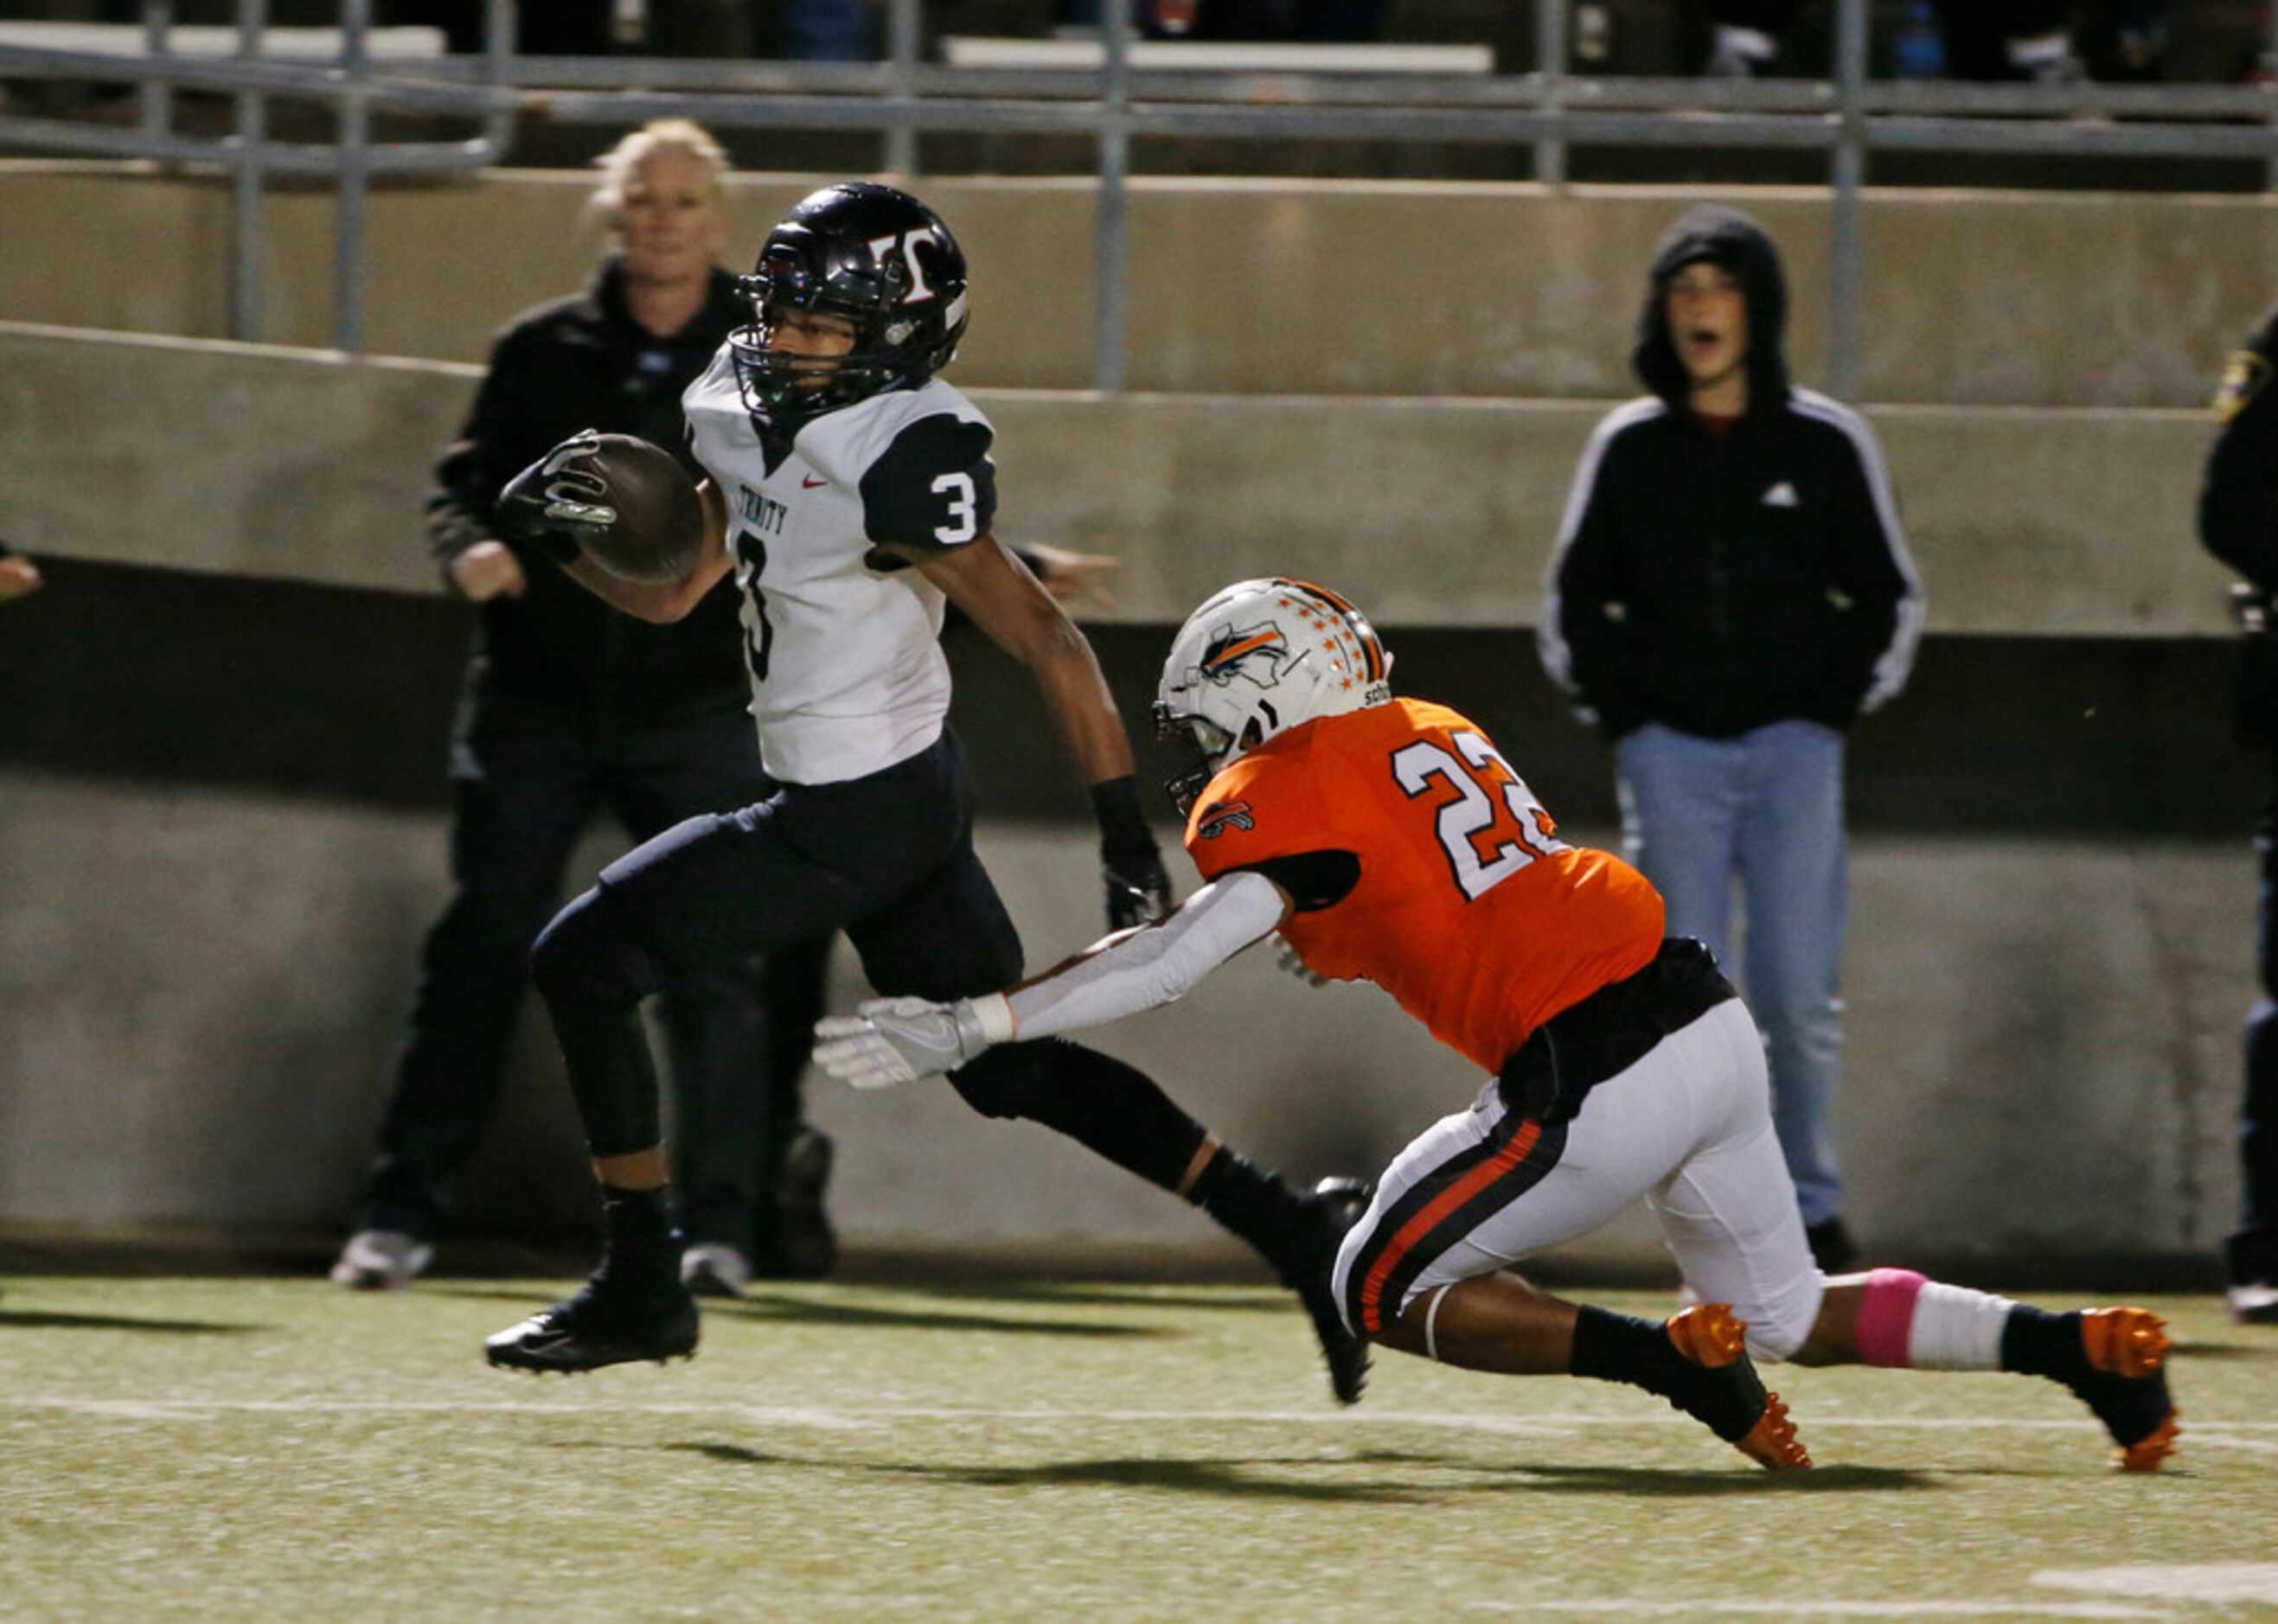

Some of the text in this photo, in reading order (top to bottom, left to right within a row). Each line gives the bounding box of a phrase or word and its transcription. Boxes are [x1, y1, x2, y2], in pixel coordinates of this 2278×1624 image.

[867, 227, 937, 304] T
[931, 470, 978, 545] 3
[738, 529, 773, 681] 3
[1391, 732, 1575, 904] 22
